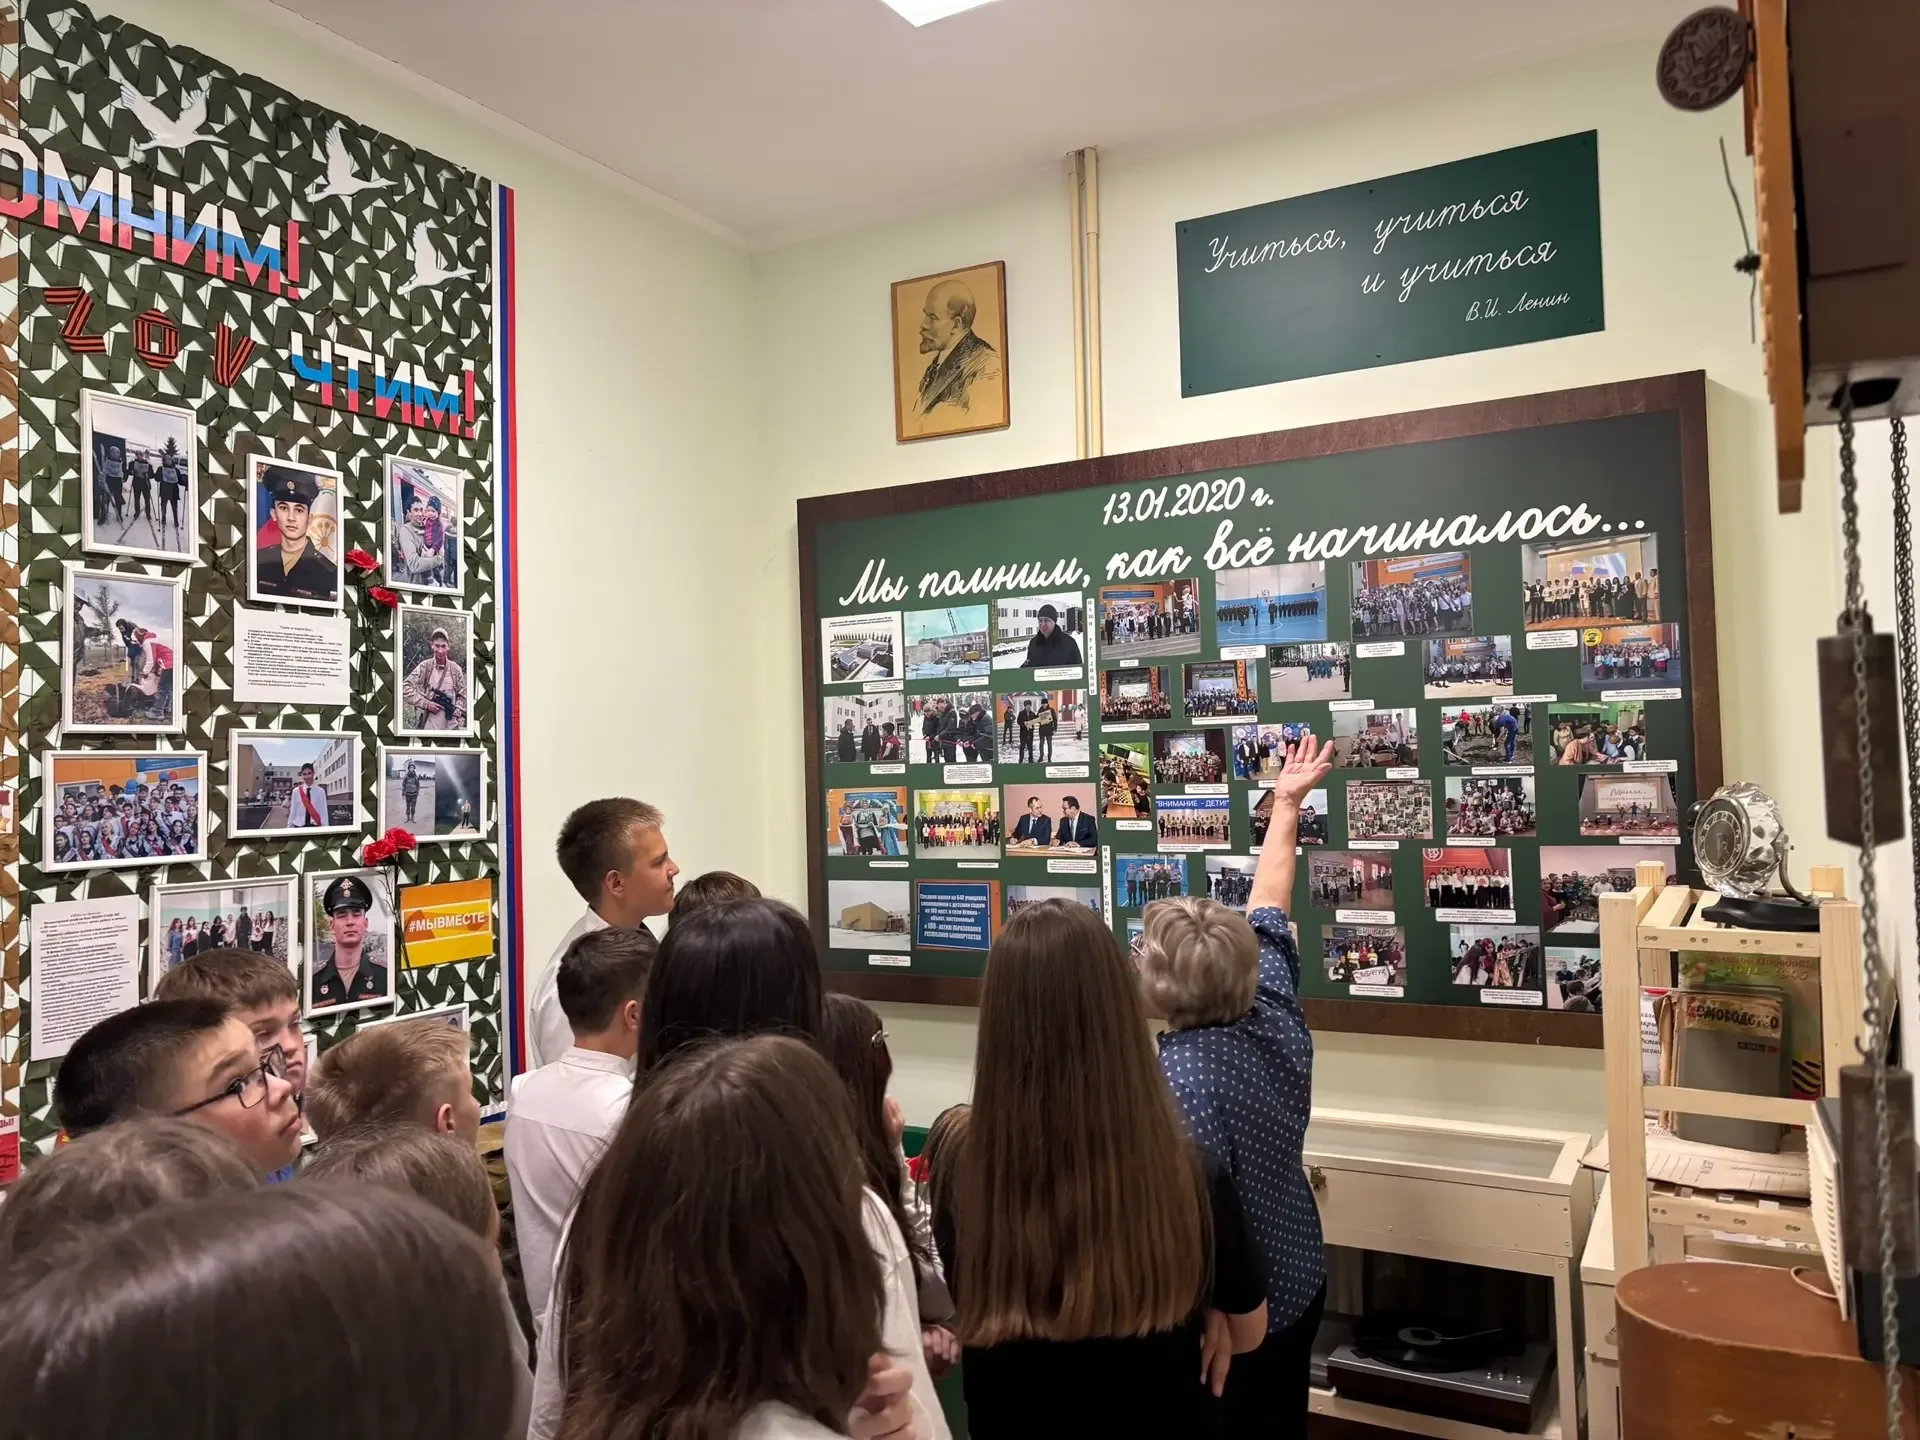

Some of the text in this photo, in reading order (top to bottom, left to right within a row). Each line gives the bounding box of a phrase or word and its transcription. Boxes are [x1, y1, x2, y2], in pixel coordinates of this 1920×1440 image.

[1204, 189, 1530, 273] Учиться, учиться
[1361, 241, 1557, 303] и учиться
[1465, 292, 1570, 322] В.И. Ленин
[290, 331, 475, 439] ЧТИМ!
[1103, 477, 1275, 525] 13.01.2020 г.
[838, 503, 1645, 606] Мы помним, как всё начиналось...
[409, 912, 485, 933] #МЫВМЕСТЕ
